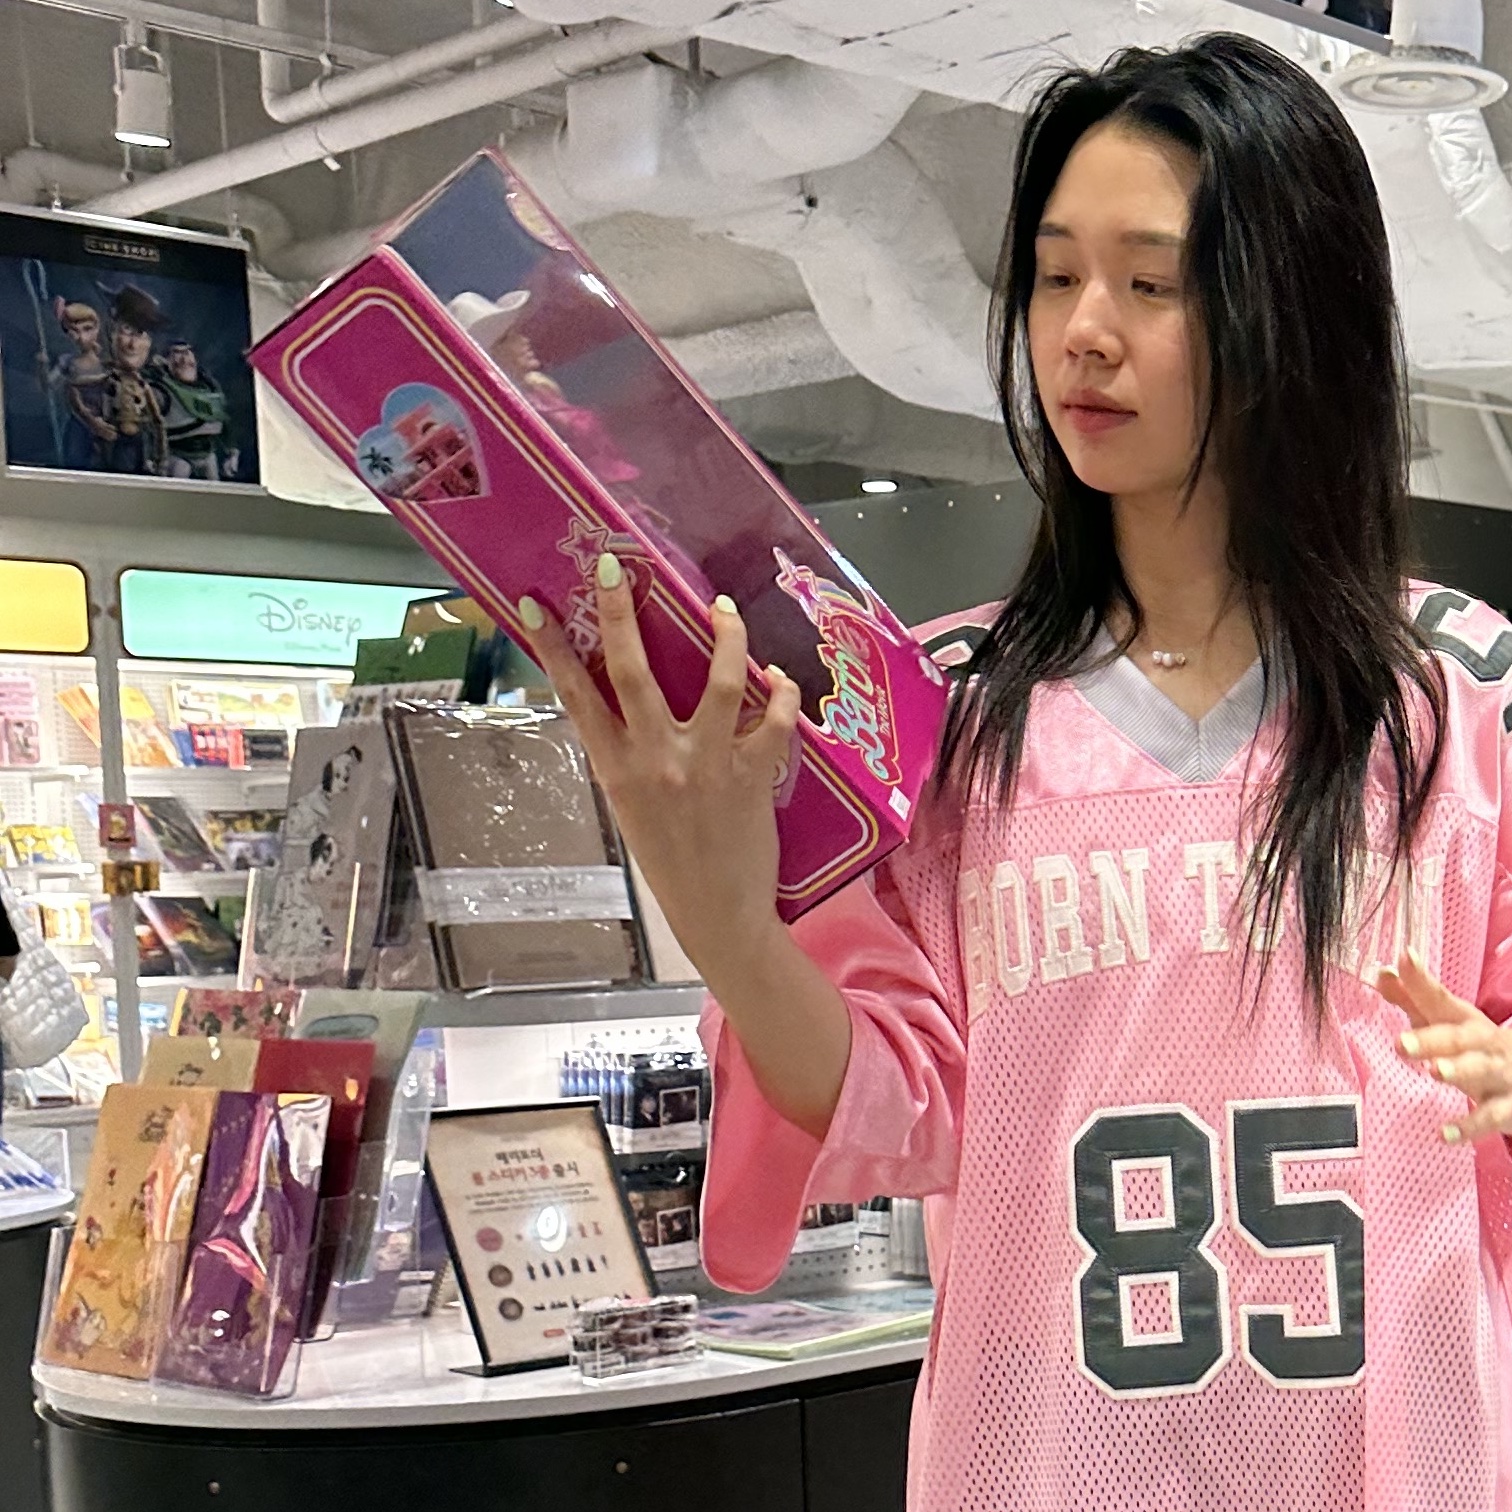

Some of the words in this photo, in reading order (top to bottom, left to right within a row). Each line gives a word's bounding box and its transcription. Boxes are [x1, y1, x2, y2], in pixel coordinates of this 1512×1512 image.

[248, 592, 362, 647] Disney
[826, 616, 889, 781] Barbie
[1068, 1094, 1365, 1400] 85
